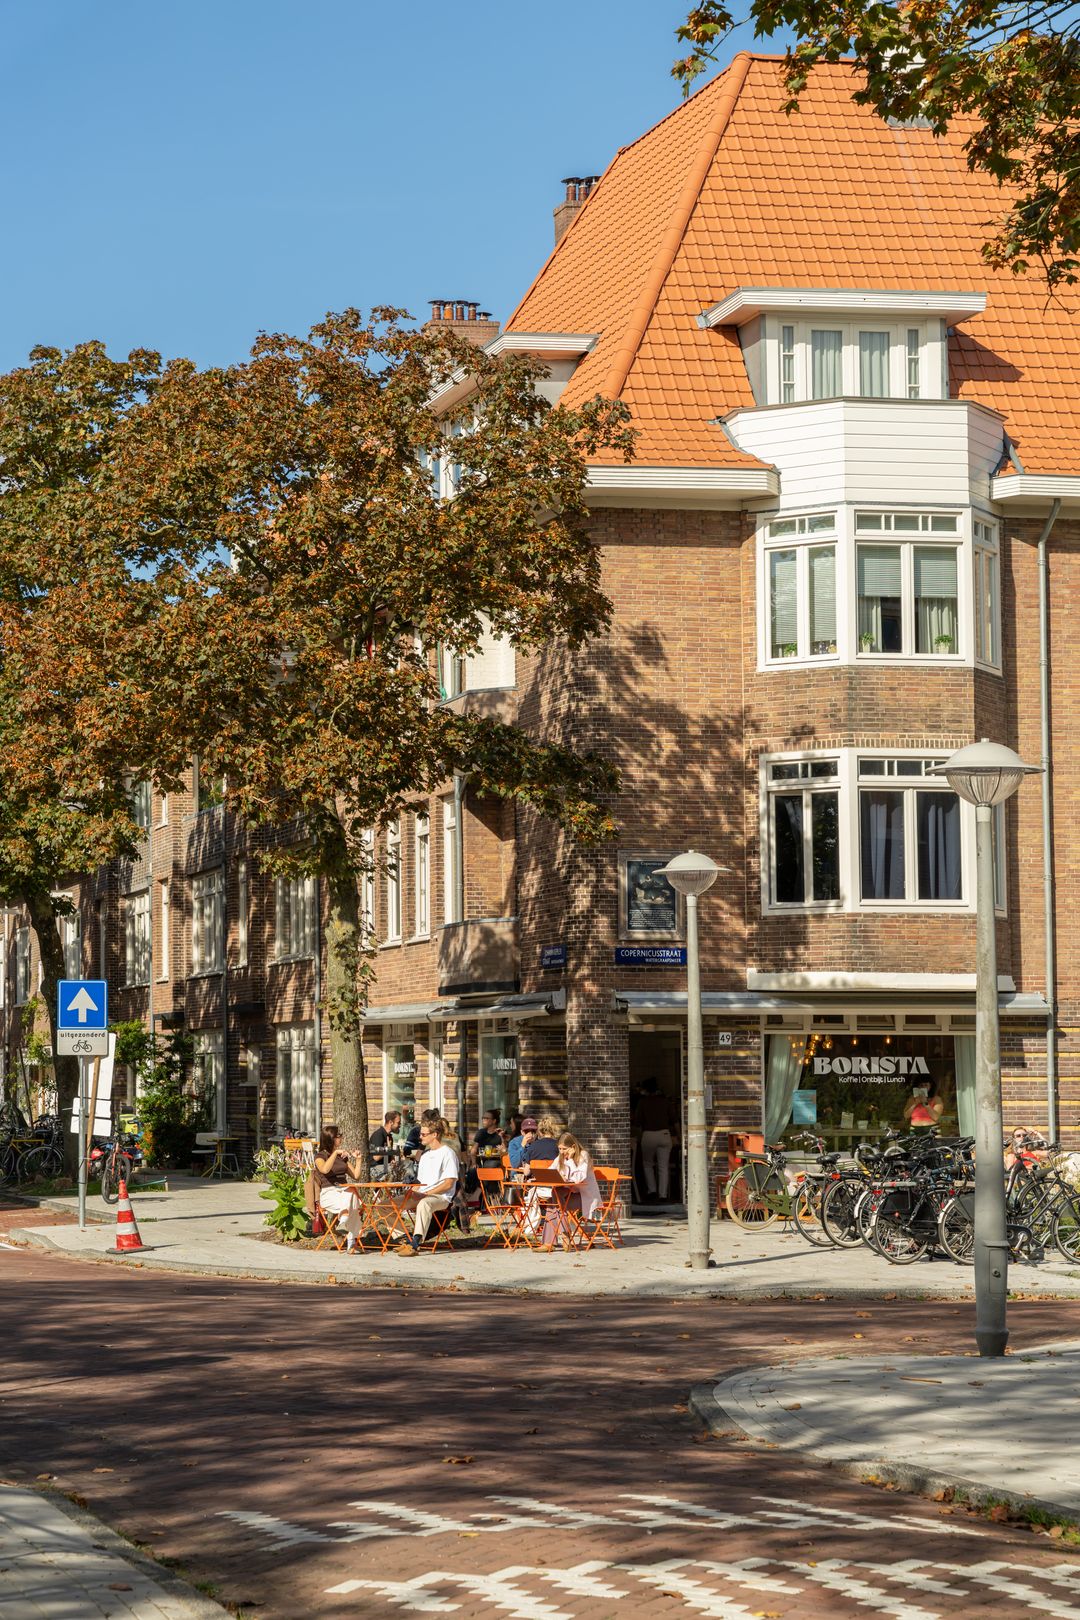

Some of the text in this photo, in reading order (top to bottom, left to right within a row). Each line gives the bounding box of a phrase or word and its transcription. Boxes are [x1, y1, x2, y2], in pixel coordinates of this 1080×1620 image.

[620, 949, 682, 957] COPERNICUSSTRAAT
[719, 1034, 731, 1043] 49
[492, 1058, 517, 1070] BORISTA
[813, 1056, 931, 1075] BORISTA
[861, 1076, 884, 1085] Ontbijt
